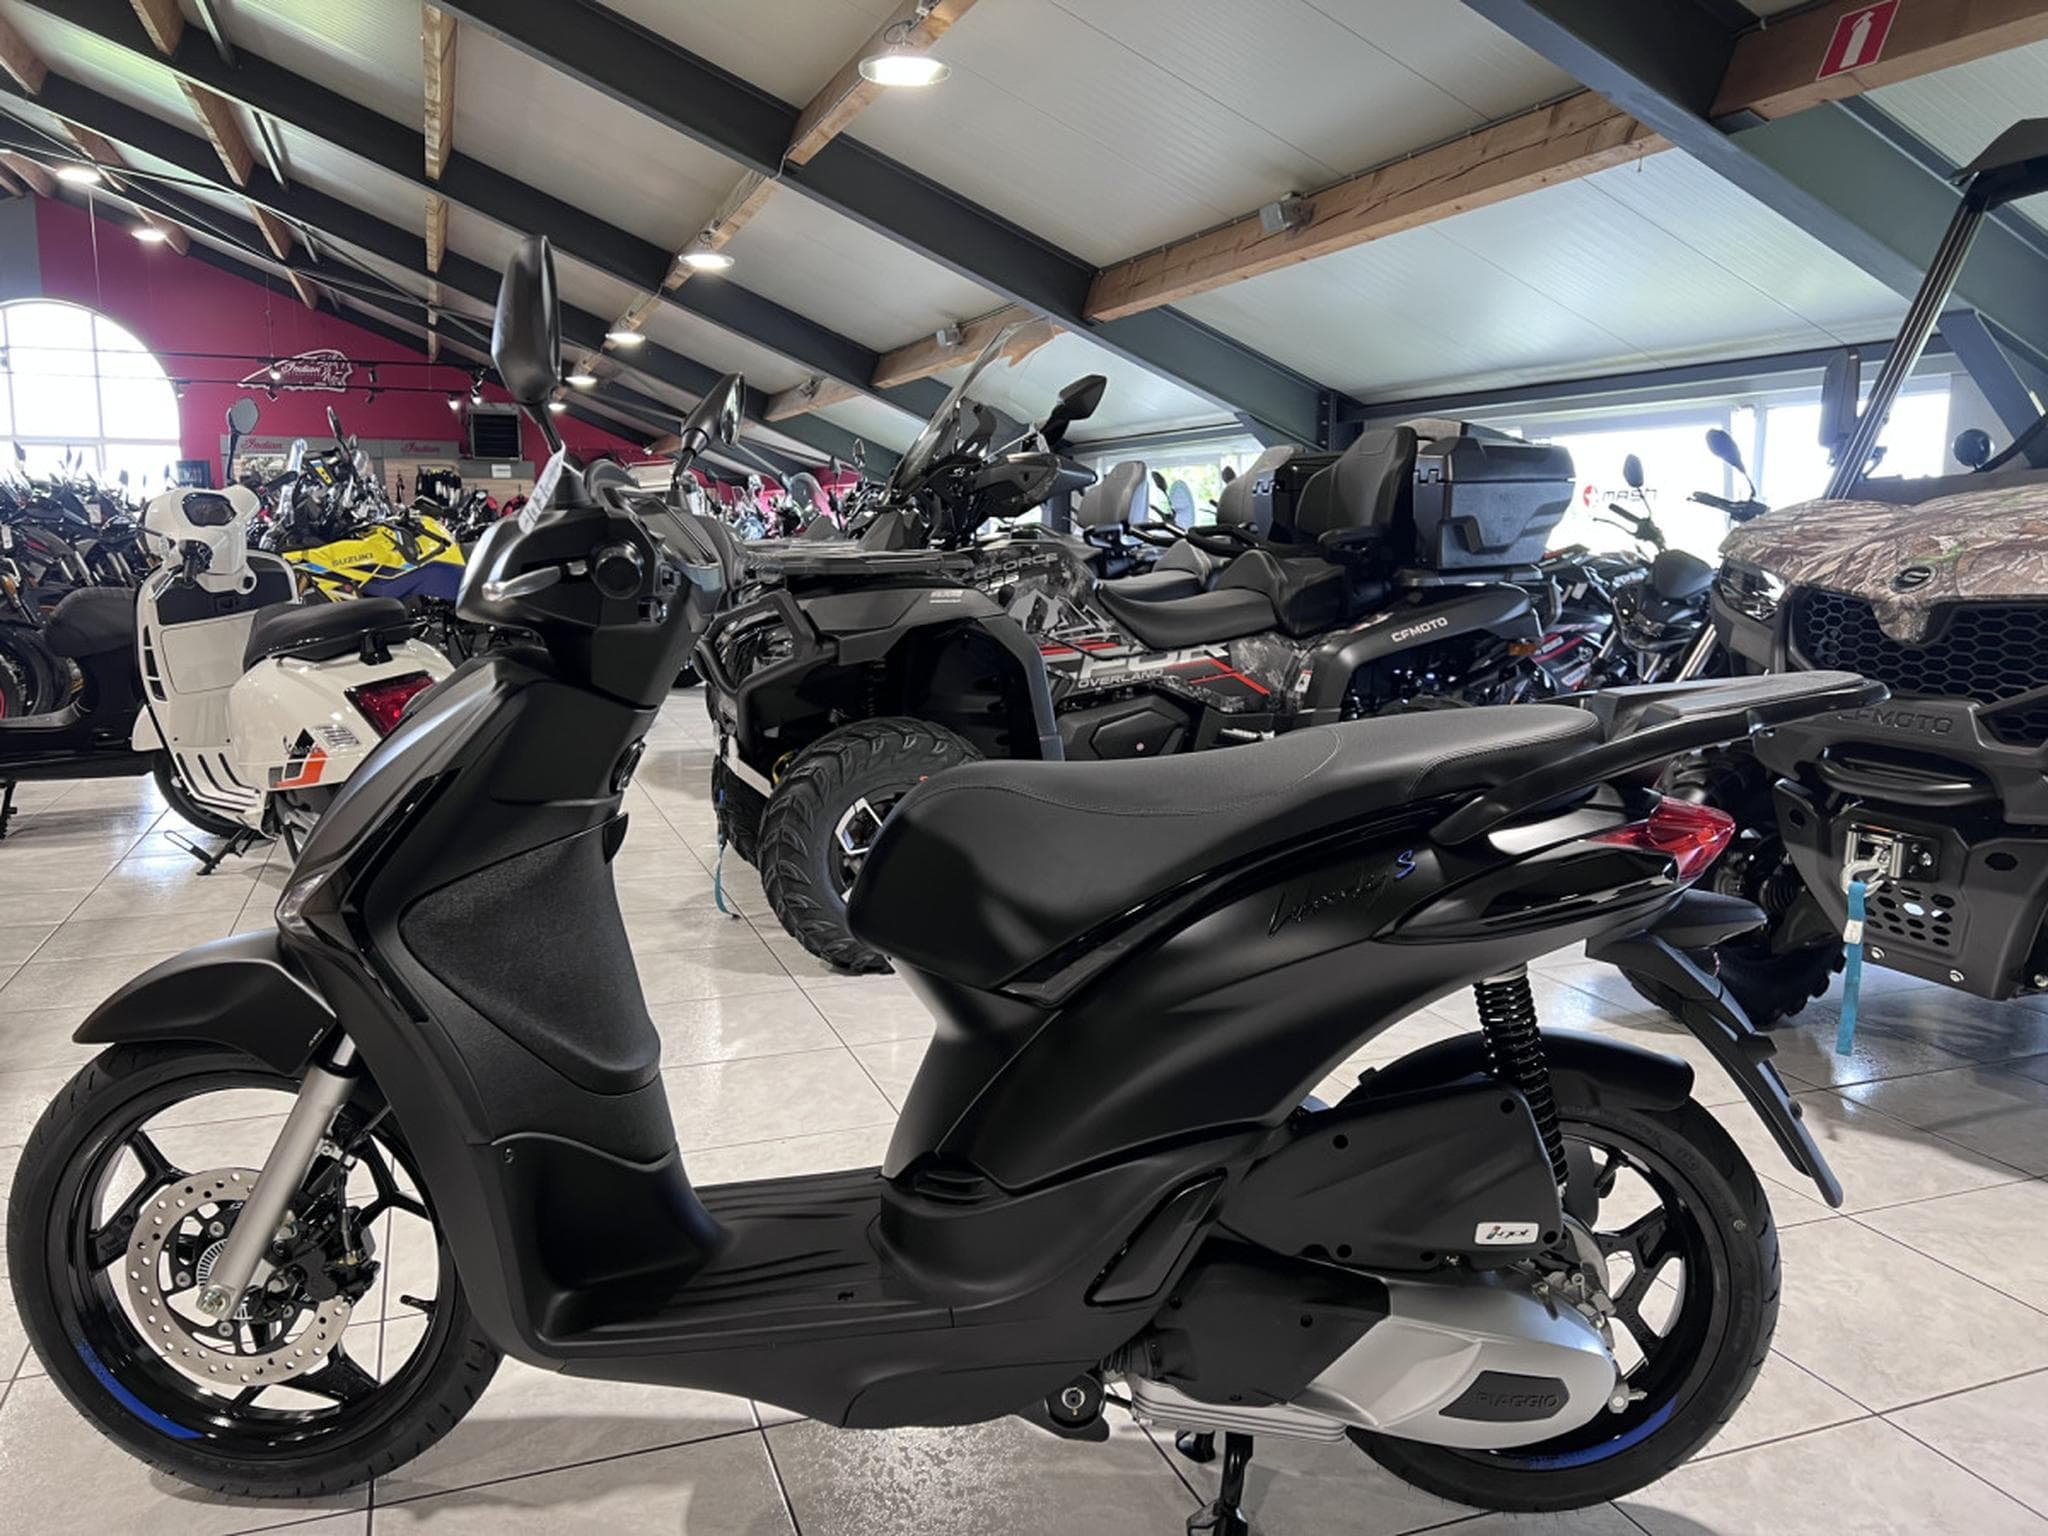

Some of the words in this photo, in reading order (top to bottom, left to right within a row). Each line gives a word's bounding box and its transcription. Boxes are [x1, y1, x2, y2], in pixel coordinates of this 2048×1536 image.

[281, 361, 320, 374] Indian
[241, 440, 282, 449] Indian
[332, 553, 374, 567] SUZUKI
[974, 552, 1058, 580] CFORCE
[1390, 617, 1448, 642] CFMOTO
[1078, 667, 1164, 689] OVERLAND
[1395, 850, 1416, 879] S
[1477, 1391, 1558, 1408] PIAGGIO
